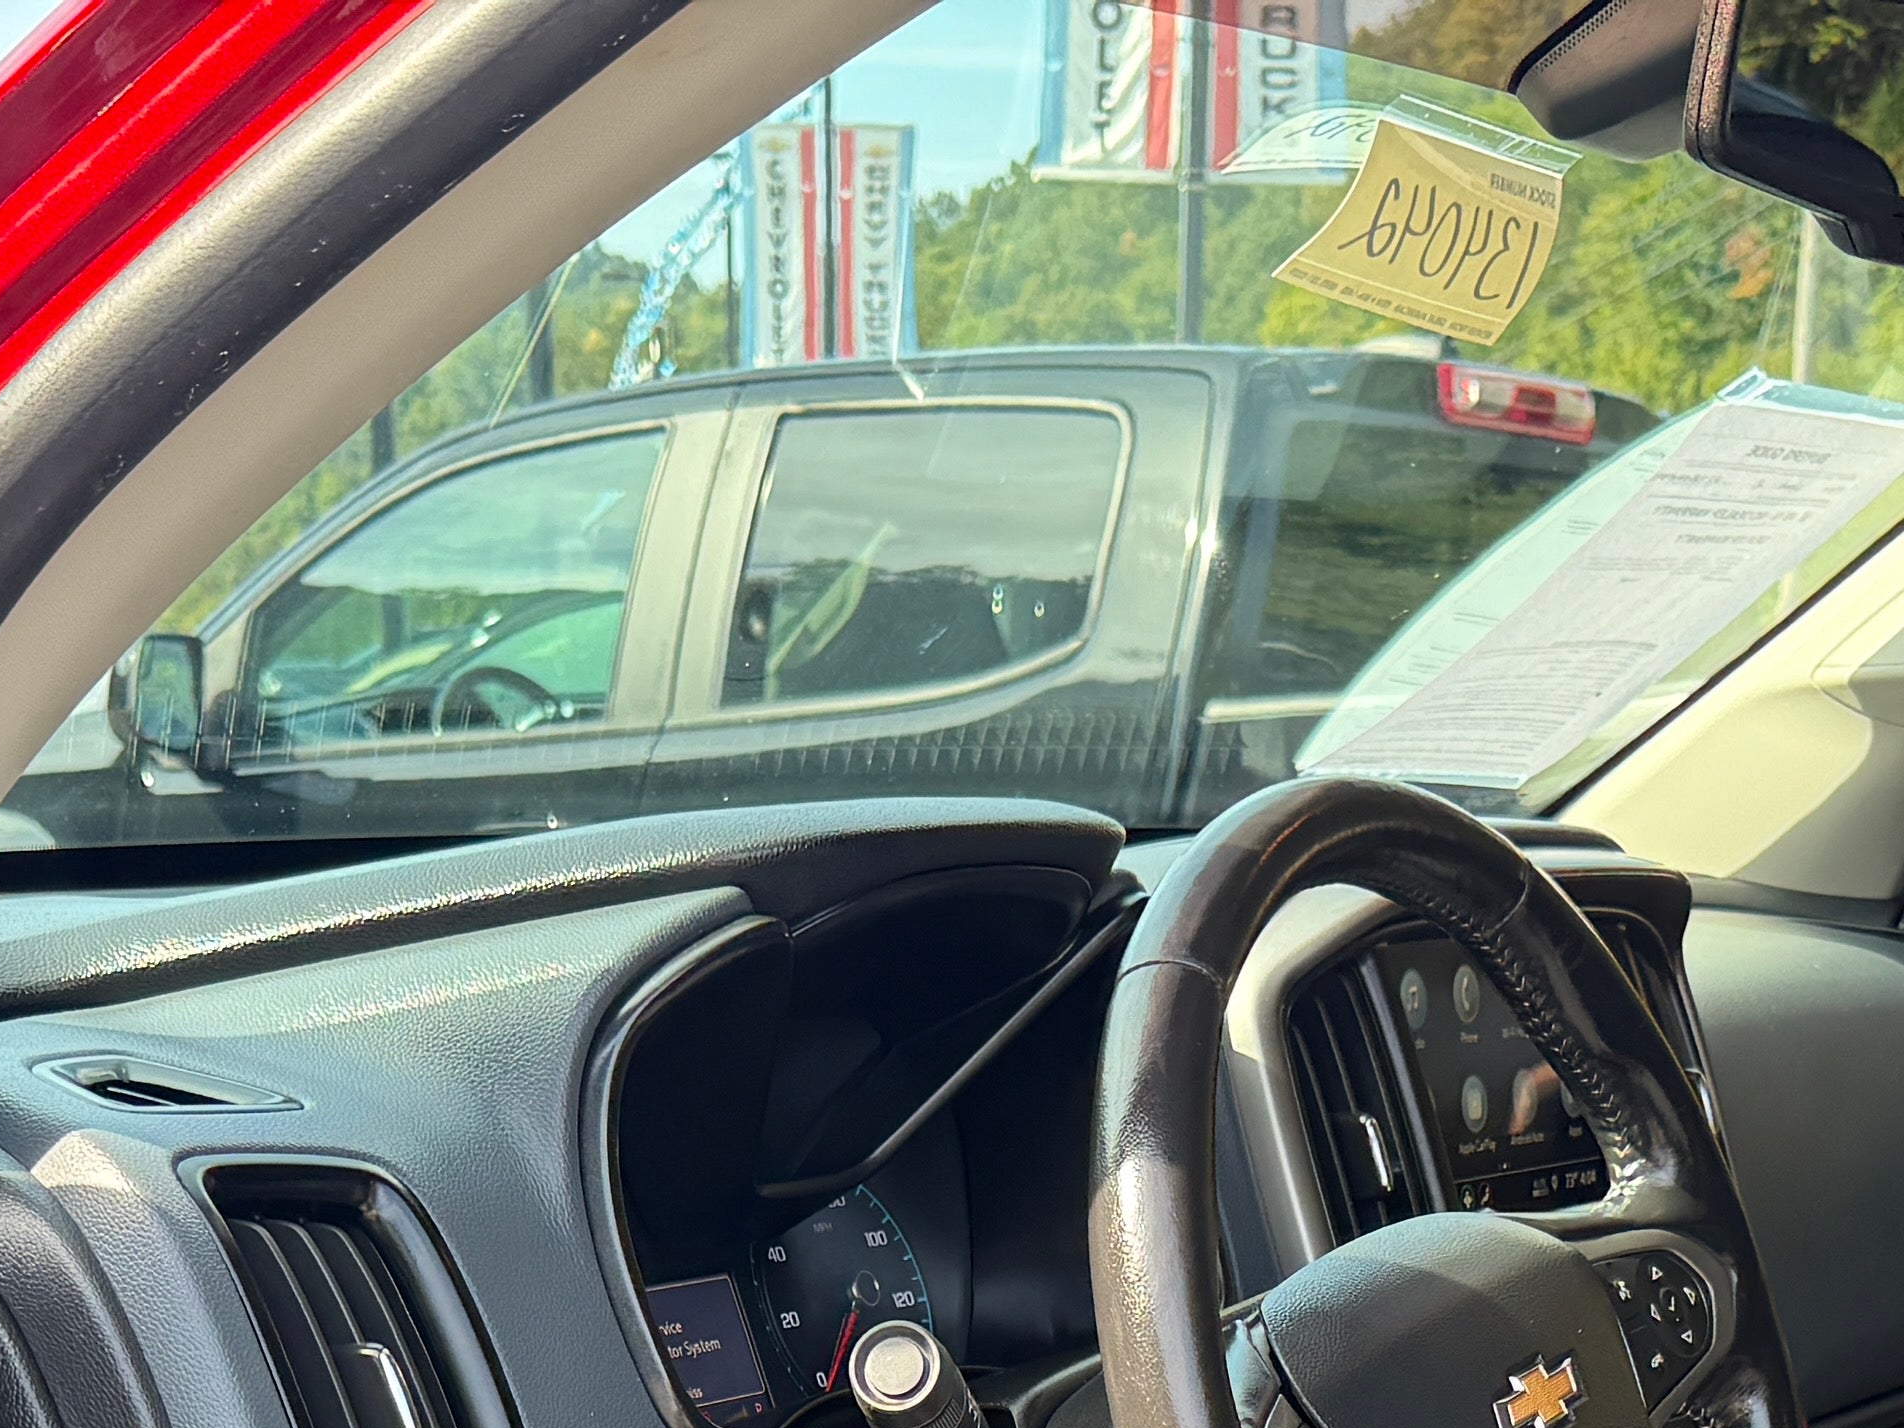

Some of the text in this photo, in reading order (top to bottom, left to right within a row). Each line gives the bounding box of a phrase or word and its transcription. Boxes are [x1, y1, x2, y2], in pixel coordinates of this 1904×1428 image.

[864, 1230, 888, 1248] 100
[767, 1246, 787, 1263] 40
[892, 1290, 915, 1309] 120
[780, 1311, 801, 1329] 20
[683, 1338, 722, 1360] System
[815, 1372, 828, 1388] 0
